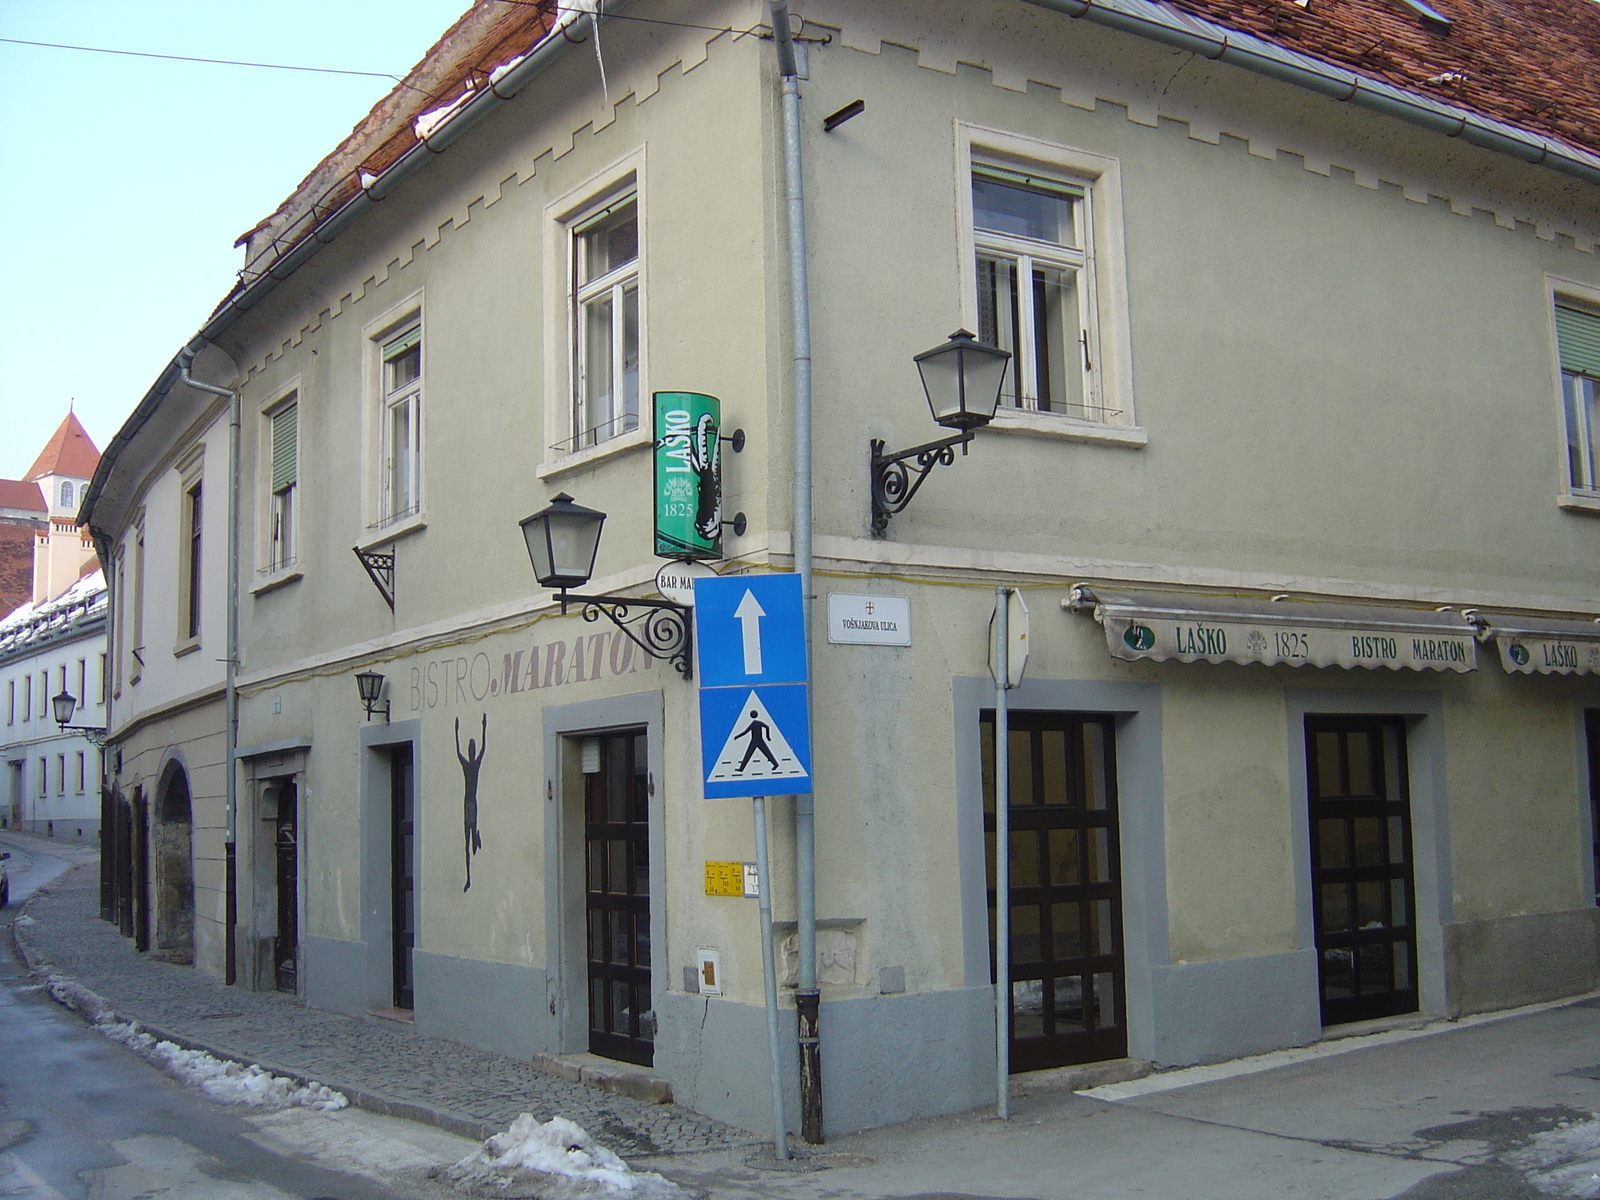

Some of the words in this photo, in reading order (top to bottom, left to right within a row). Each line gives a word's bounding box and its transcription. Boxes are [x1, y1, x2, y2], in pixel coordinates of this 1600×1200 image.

[659, 410, 691, 473] LAŠKO
[664, 503, 693, 517] 1825
[660, 575, 677, 589] BAR
[880, 620, 898, 632] ULICA
[1175, 622, 1227, 655] LAŠKO
[1273, 631, 1310, 658] 1825
[1352, 635, 1397, 659] BISTRO
[1412, 638, 1466, 662] MARATON
[1543, 641, 1577, 668] LAŠKO
[411, 652, 490, 711] BISTRO
